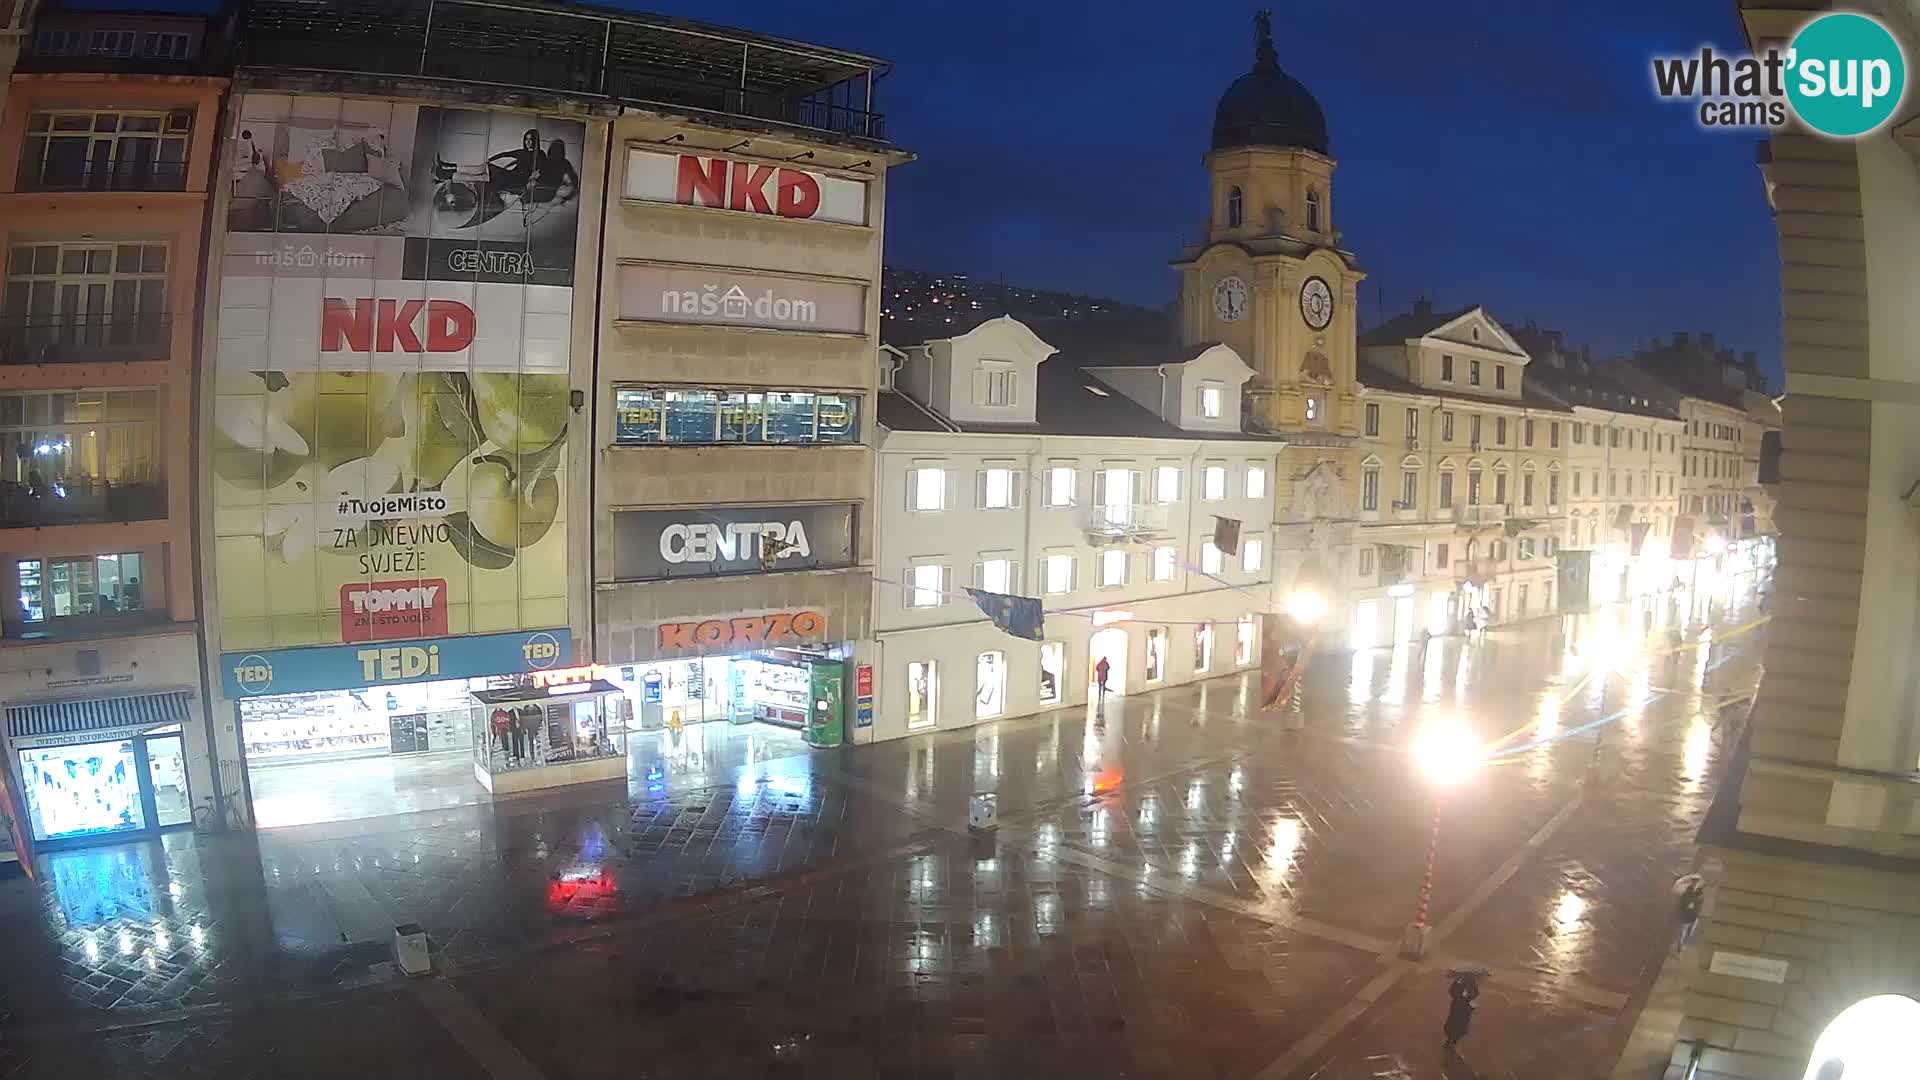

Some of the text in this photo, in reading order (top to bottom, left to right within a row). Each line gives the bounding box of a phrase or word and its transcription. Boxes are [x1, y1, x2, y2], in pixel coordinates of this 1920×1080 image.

[676, 155, 820, 218] NKD
[448, 249, 535, 275] CENTRA
[661, 283, 817, 322] naš dom
[321, 297, 477, 352] NKD
[338, 497, 446, 516] #TvojeMisto
[333, 523, 451, 549] ZA DNEVNO
[659, 520, 811, 563] CENTRA
[359, 547, 427, 575] SVJEŽE
[349, 585, 440, 614] TOMMY
[659, 611, 825, 650] KORZO
[357, 645, 440, 681] TEDi
[522, 642, 561, 660] TEDi
[233, 664, 273, 683] TEDi
